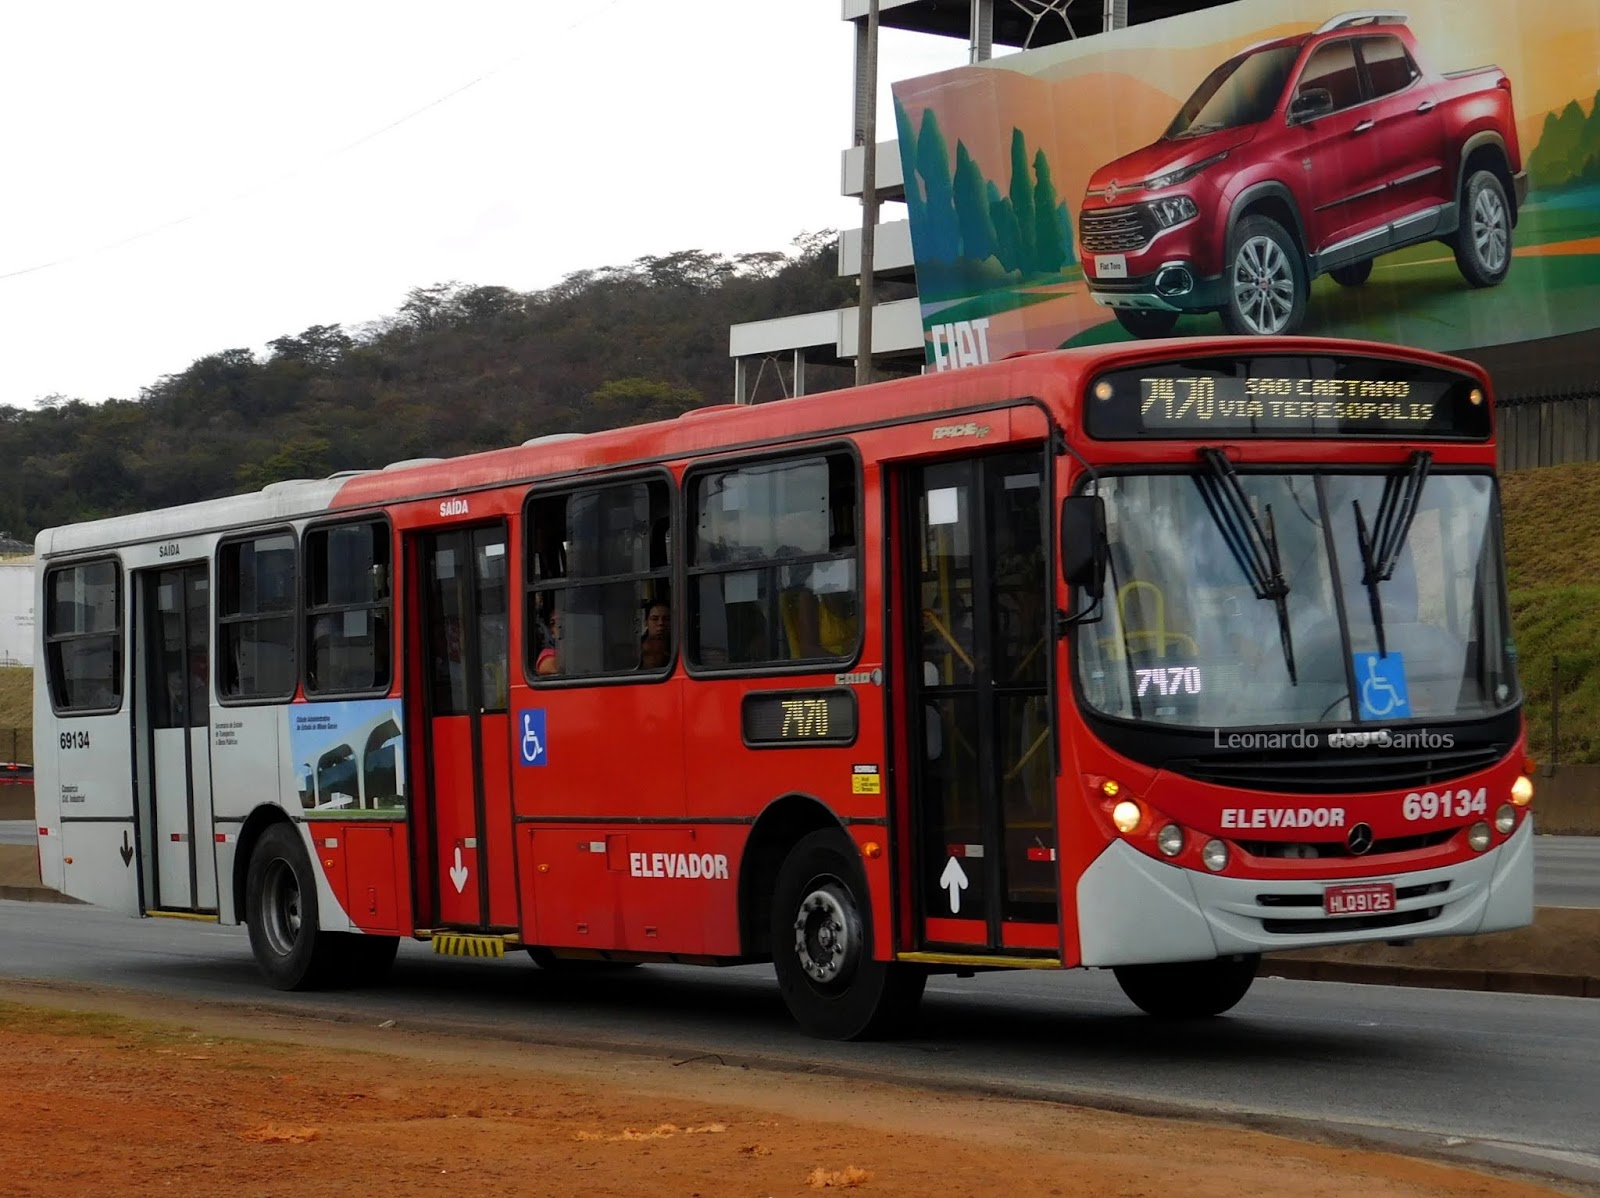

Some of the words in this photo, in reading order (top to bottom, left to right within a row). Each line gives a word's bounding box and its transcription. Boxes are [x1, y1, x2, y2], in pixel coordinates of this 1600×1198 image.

[931, 318, 989, 373] FIAT
[1139, 376, 1215, 420] 7470
[1296, 379, 1410, 398] CAETANO
[1218, 400, 1264, 417] VIA
[1268, 401, 1435, 420] TERESOPOLIS
[440, 497, 469, 517] SAÍDA
[159, 541, 180, 558] SAÍDA
[1135, 666, 1201, 697] 7470
[781, 699, 829, 737] 7470
[60, 730, 90, 750] 69134
[1402, 787, 1488, 821] 69134
[1220, 807, 1346, 828] ELEVADOR
[630, 852, 729, 880] ELEVADOR
